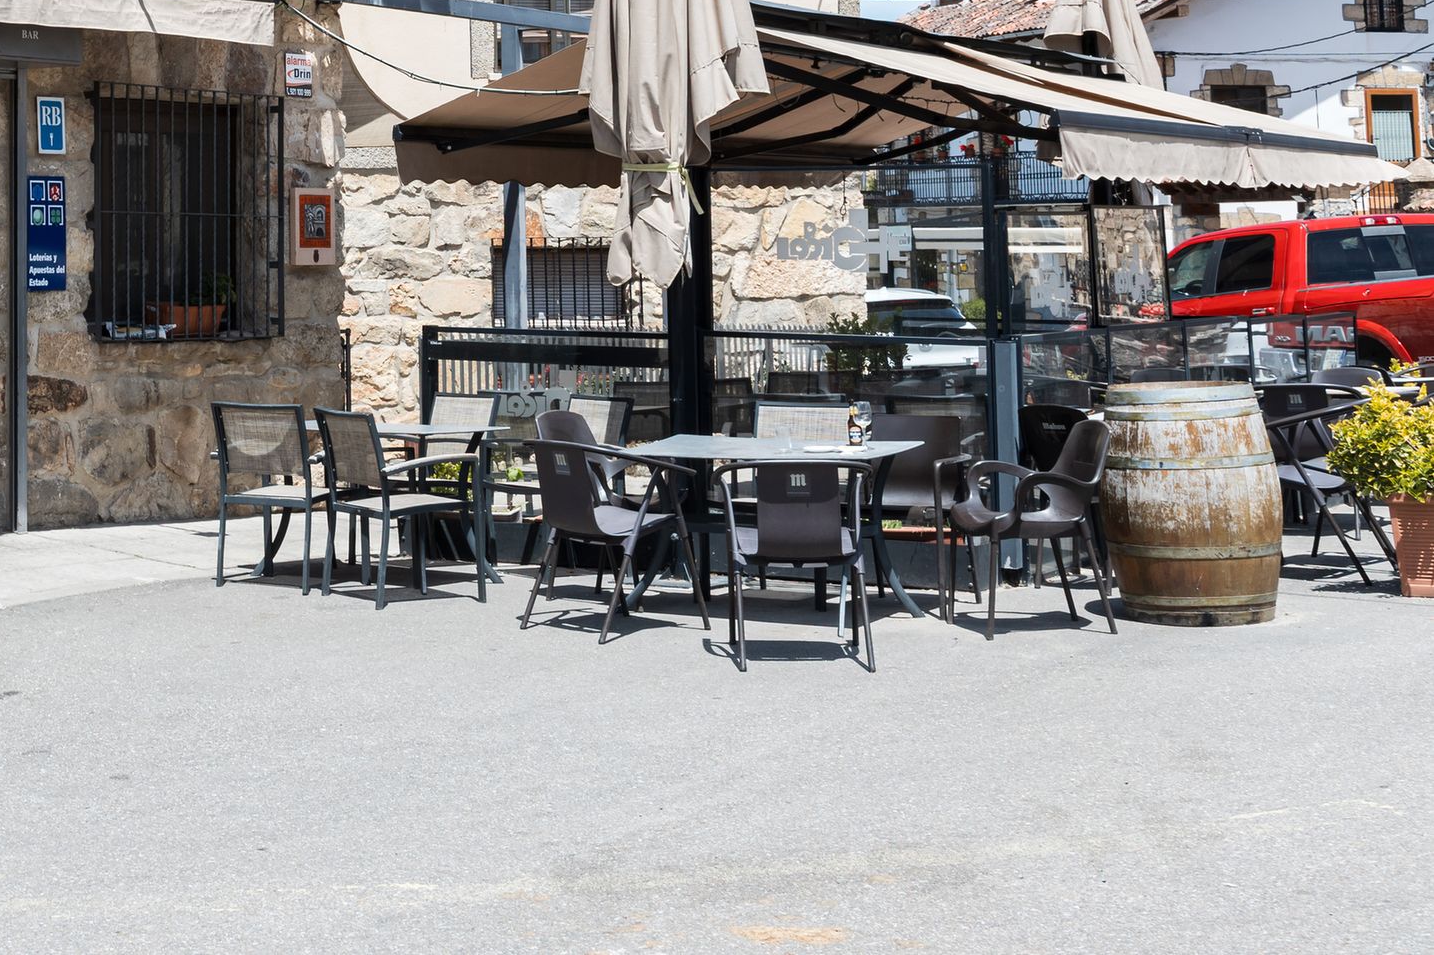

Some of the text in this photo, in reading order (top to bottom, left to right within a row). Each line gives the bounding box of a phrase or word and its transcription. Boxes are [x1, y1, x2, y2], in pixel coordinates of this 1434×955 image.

[21, 29, 39, 40] BAR
[294, 68, 311, 79] Drin
[41, 105, 62, 126] RB
[53, 255, 58, 263] y
[29, 265, 65, 276] Apuestas del
[29, 277, 49, 286] Estado
